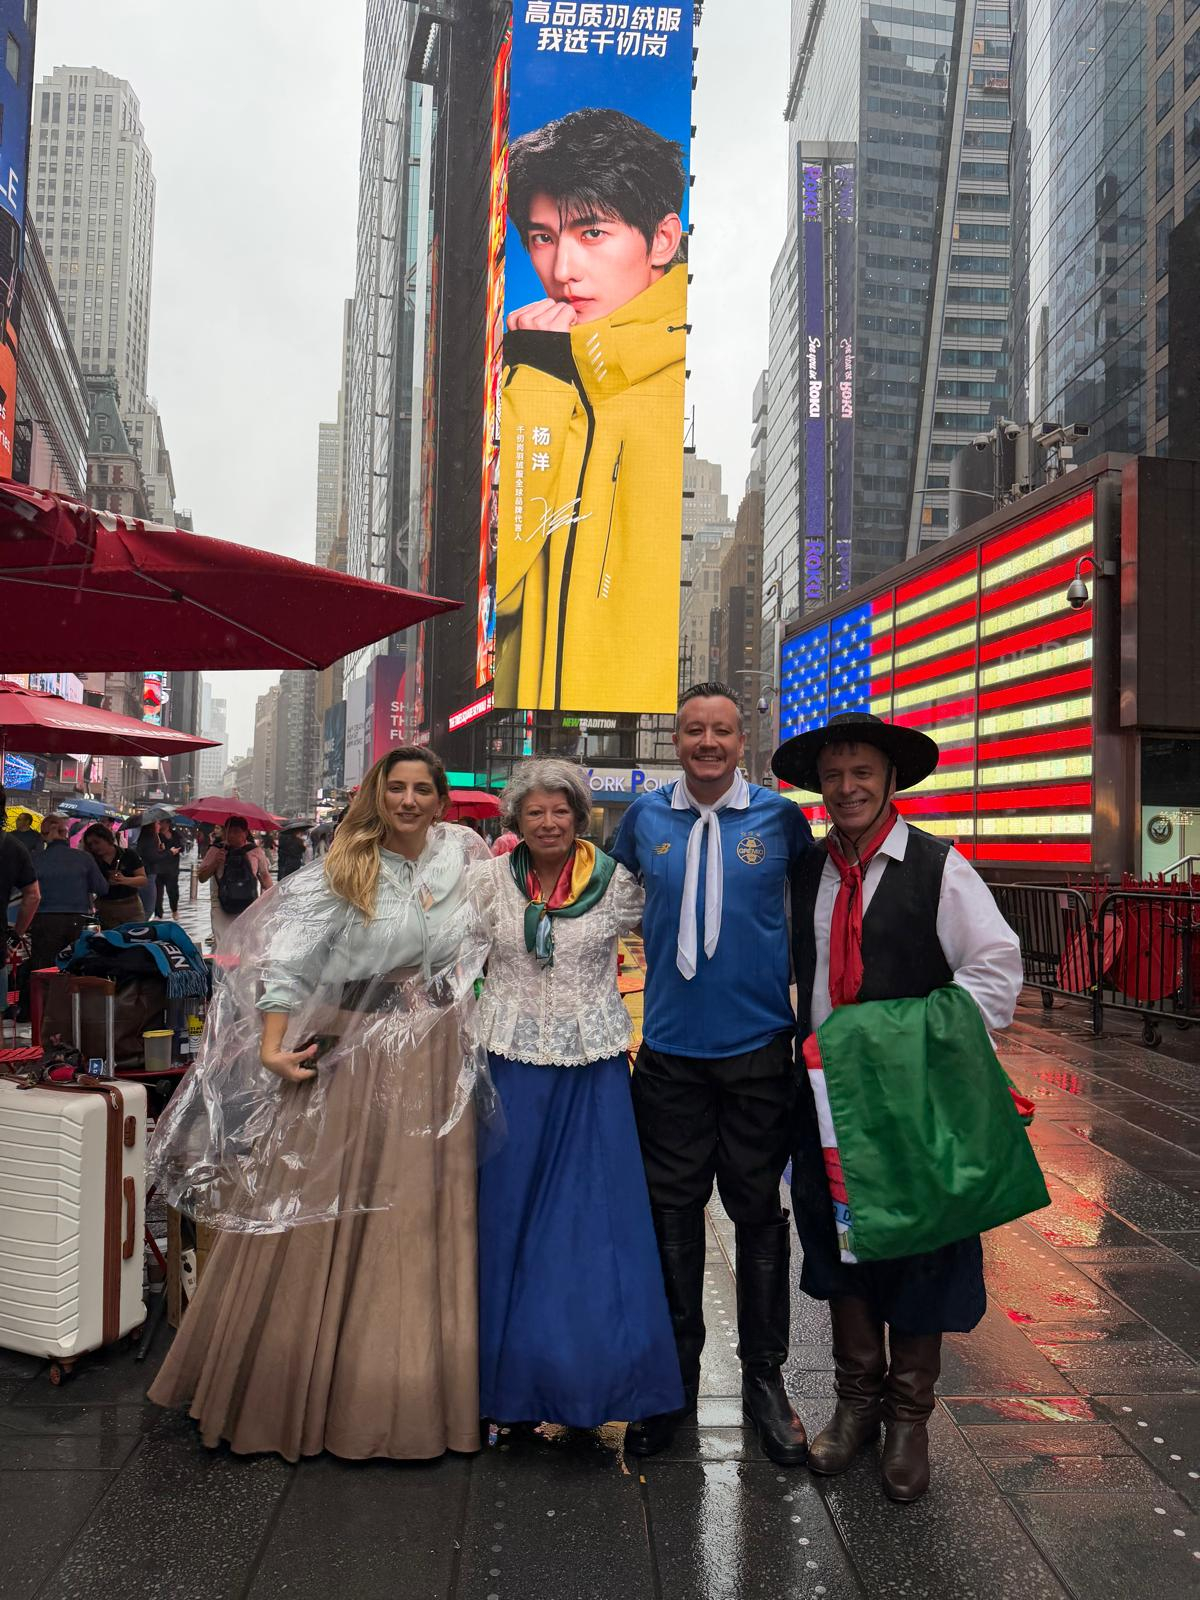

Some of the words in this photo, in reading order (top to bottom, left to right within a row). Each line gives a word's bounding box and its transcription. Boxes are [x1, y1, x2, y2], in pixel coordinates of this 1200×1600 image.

[525, 0, 682, 31] 高品质羽绒服
[537, 27, 667, 57] 我选千仞岗
[532, 427, 551, 471] 杨洋
